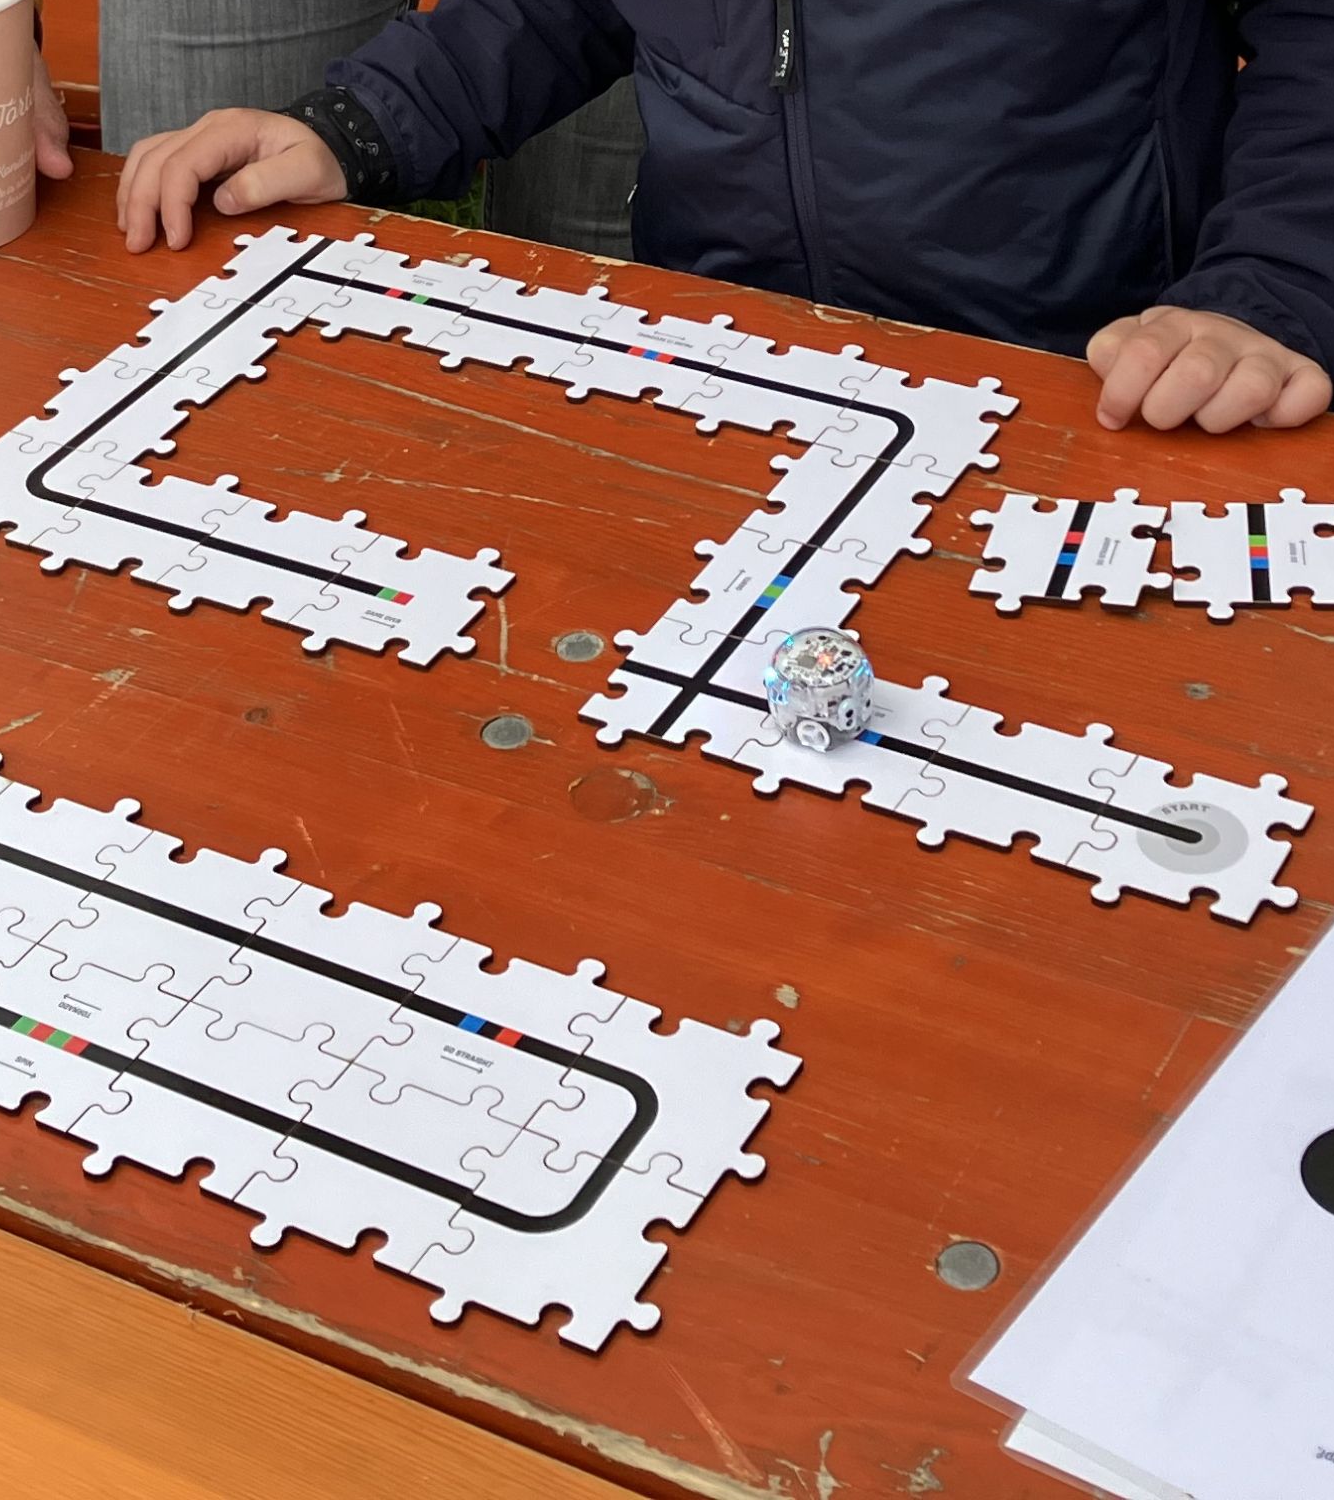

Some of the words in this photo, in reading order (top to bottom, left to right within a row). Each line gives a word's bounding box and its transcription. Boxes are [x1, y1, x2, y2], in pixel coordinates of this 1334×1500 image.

[1160, 802, 1211, 815] START
[57, 1001, 92, 1019] TORNADO
[14, 1055, 35, 1068] SPIN
[455, 1047, 495, 1068] STRAIGHT
